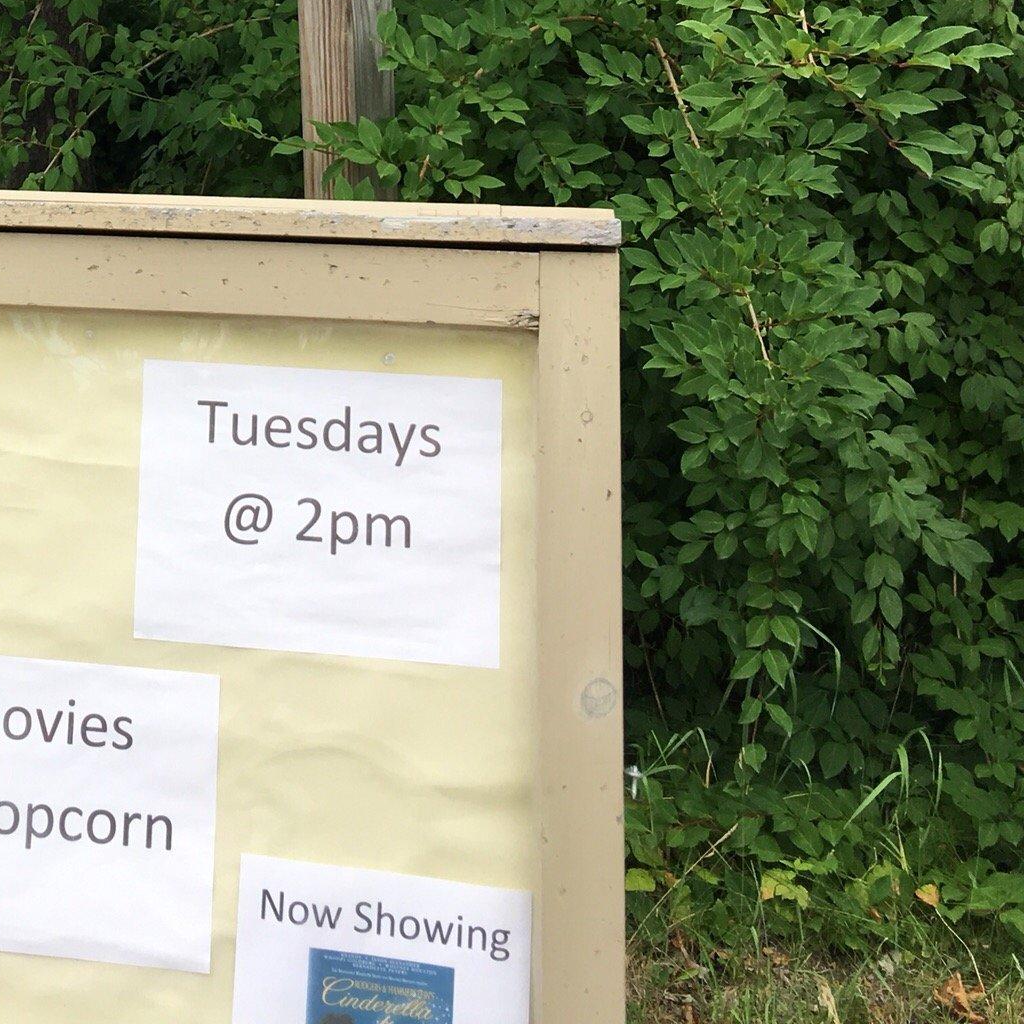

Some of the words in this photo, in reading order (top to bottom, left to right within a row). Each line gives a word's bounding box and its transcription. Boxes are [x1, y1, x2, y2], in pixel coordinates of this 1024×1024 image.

[197, 400, 441, 467] Tuesdays
[224, 493, 273, 545] @
[295, 497, 411, 556] 2pm
[260, 888, 343, 930] Now
[353, 901, 511, 962] Showing
[322, 976, 432, 1019] Cinderella
